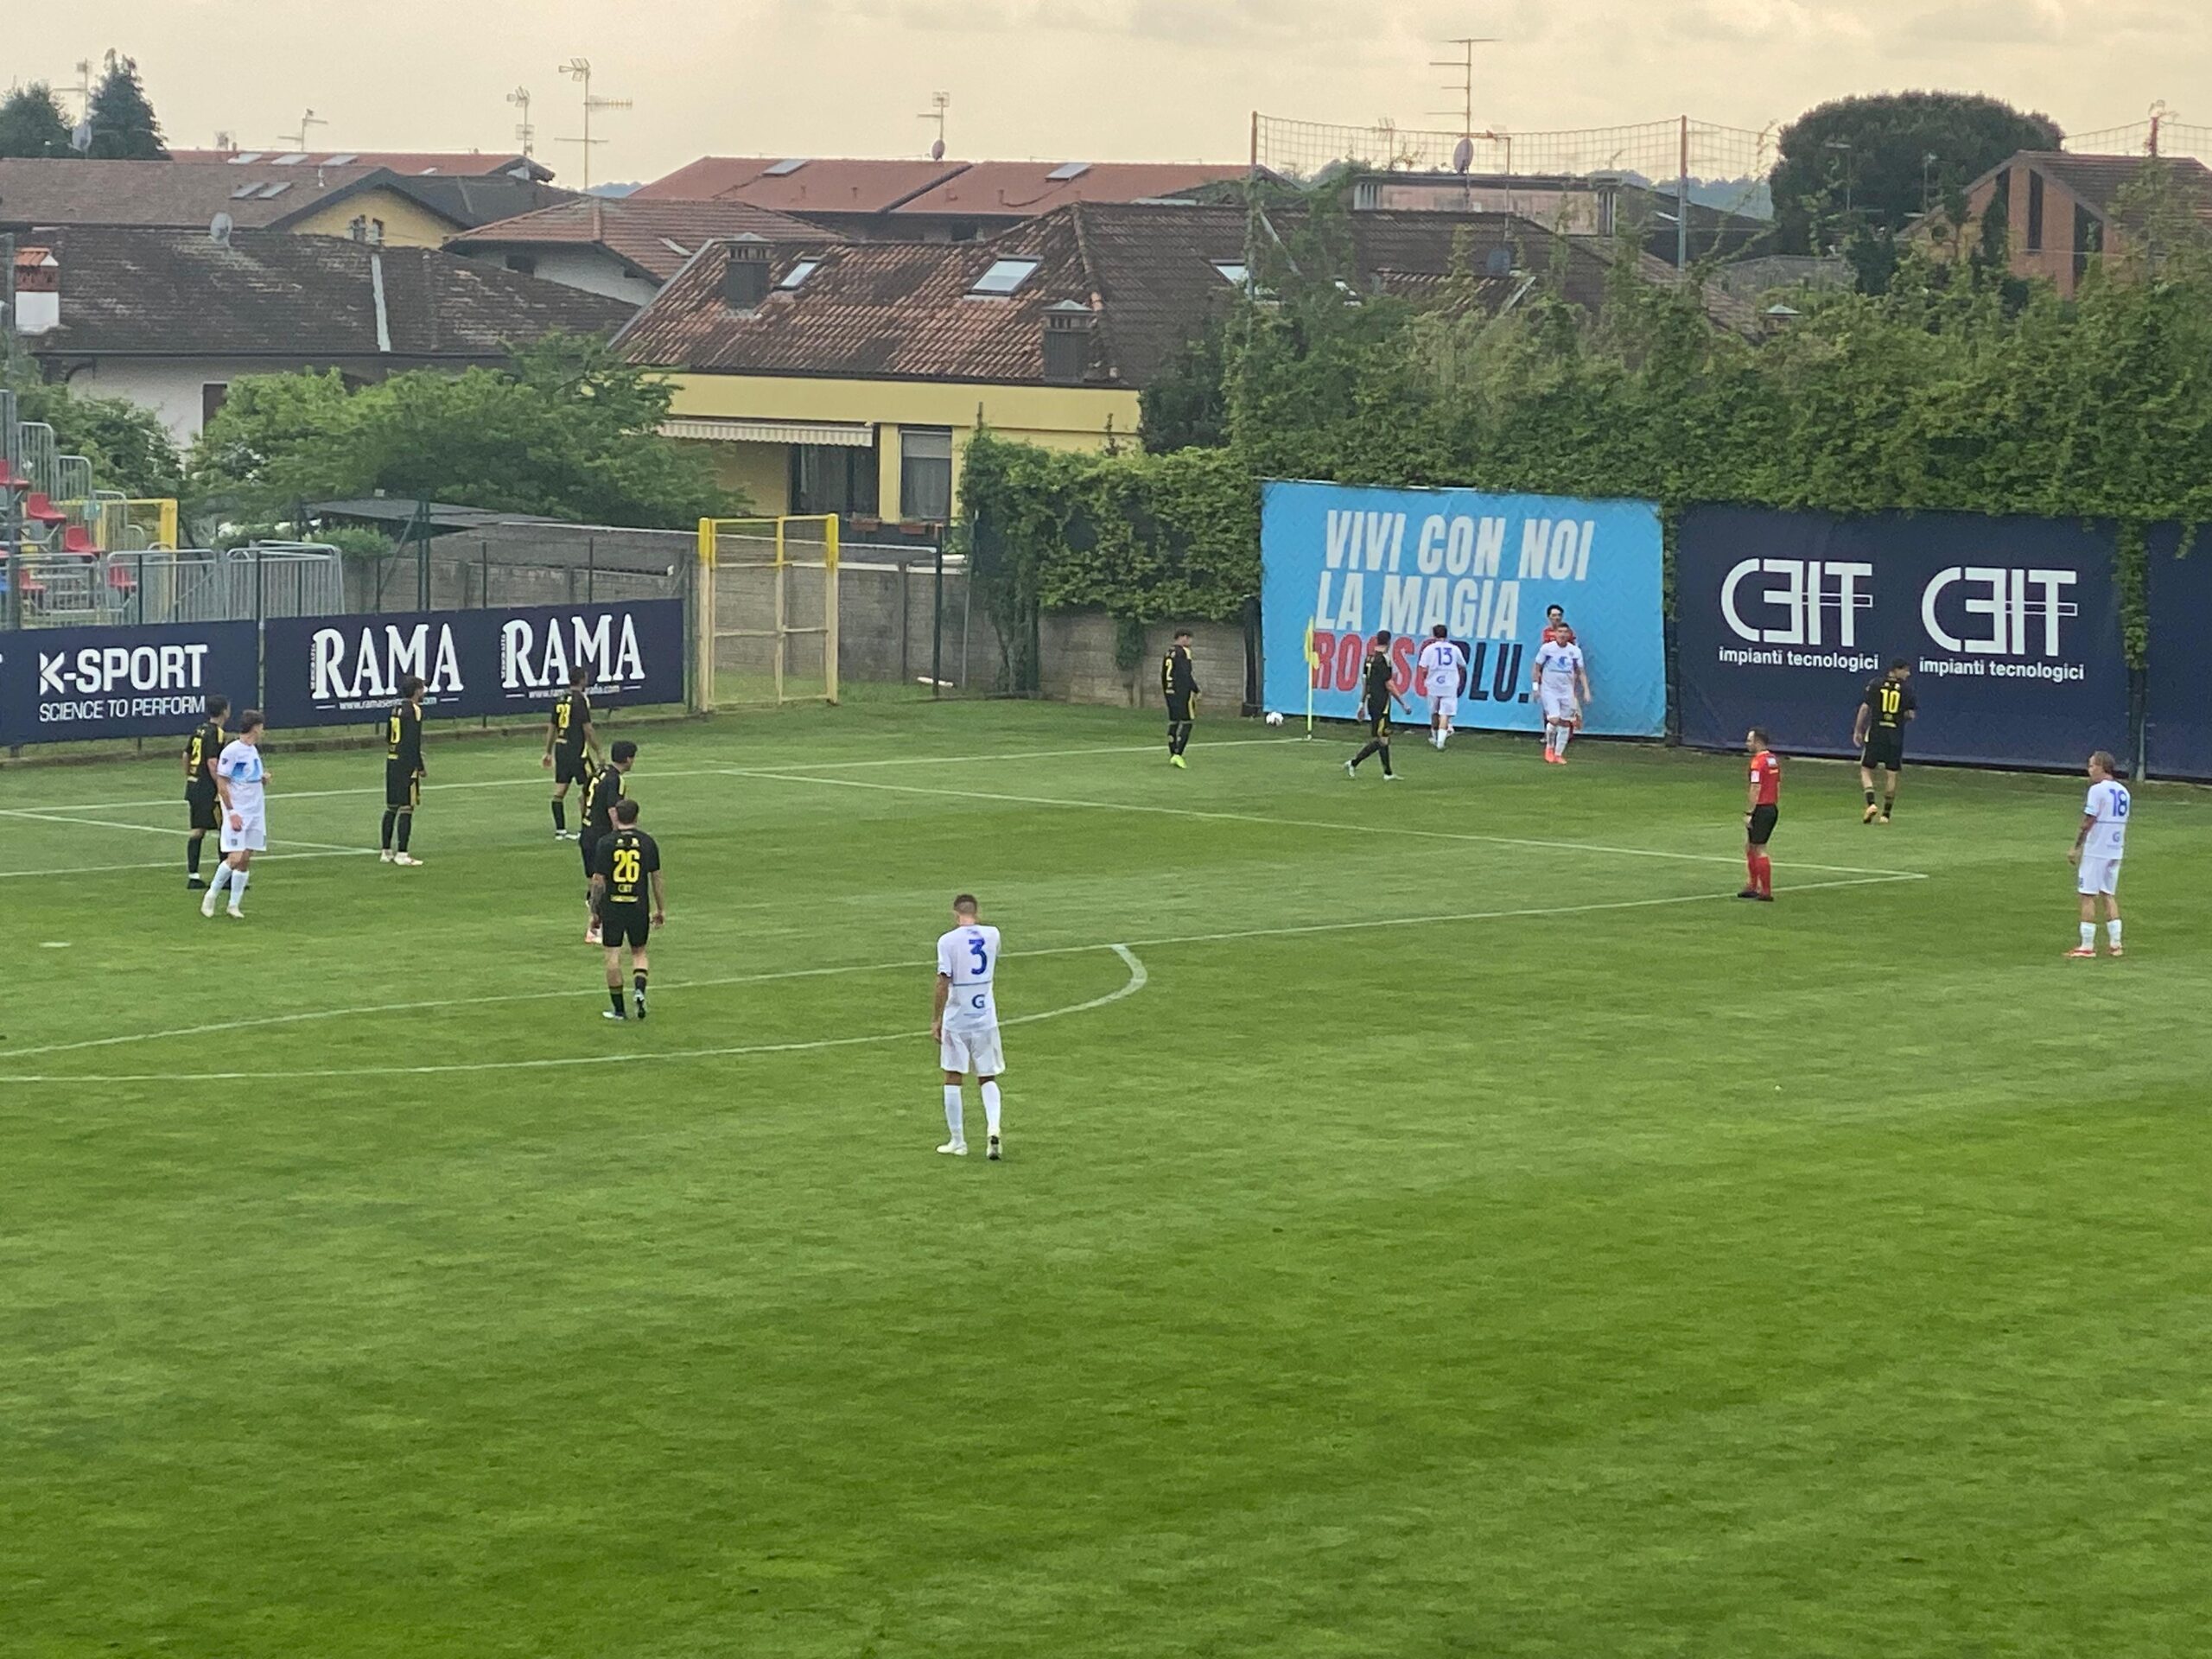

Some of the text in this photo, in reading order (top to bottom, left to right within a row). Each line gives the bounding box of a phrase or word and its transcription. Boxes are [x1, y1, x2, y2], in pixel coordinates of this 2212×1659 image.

[1325, 510, 1595, 581] VIVI CON NOI
[1315, 571, 1520, 639] LA MAGIA
[312, 623, 464, 699] RAMA
[502, 613, 645, 688] RAMA
[1434, 647, 1452, 665] 13
[1719, 646, 1879, 672] impianti tecnologici
[39, 644, 208, 696] K-SPORT
[1919, 656, 2084, 683] impianti tecnologici
[39, 695, 206, 722] SCIENCE TO PERFORM
[1879, 689, 1901, 714] 10
[2109, 788, 2127, 817] 18
[613, 849, 640, 883] 26
[969, 938, 987, 976] 3
